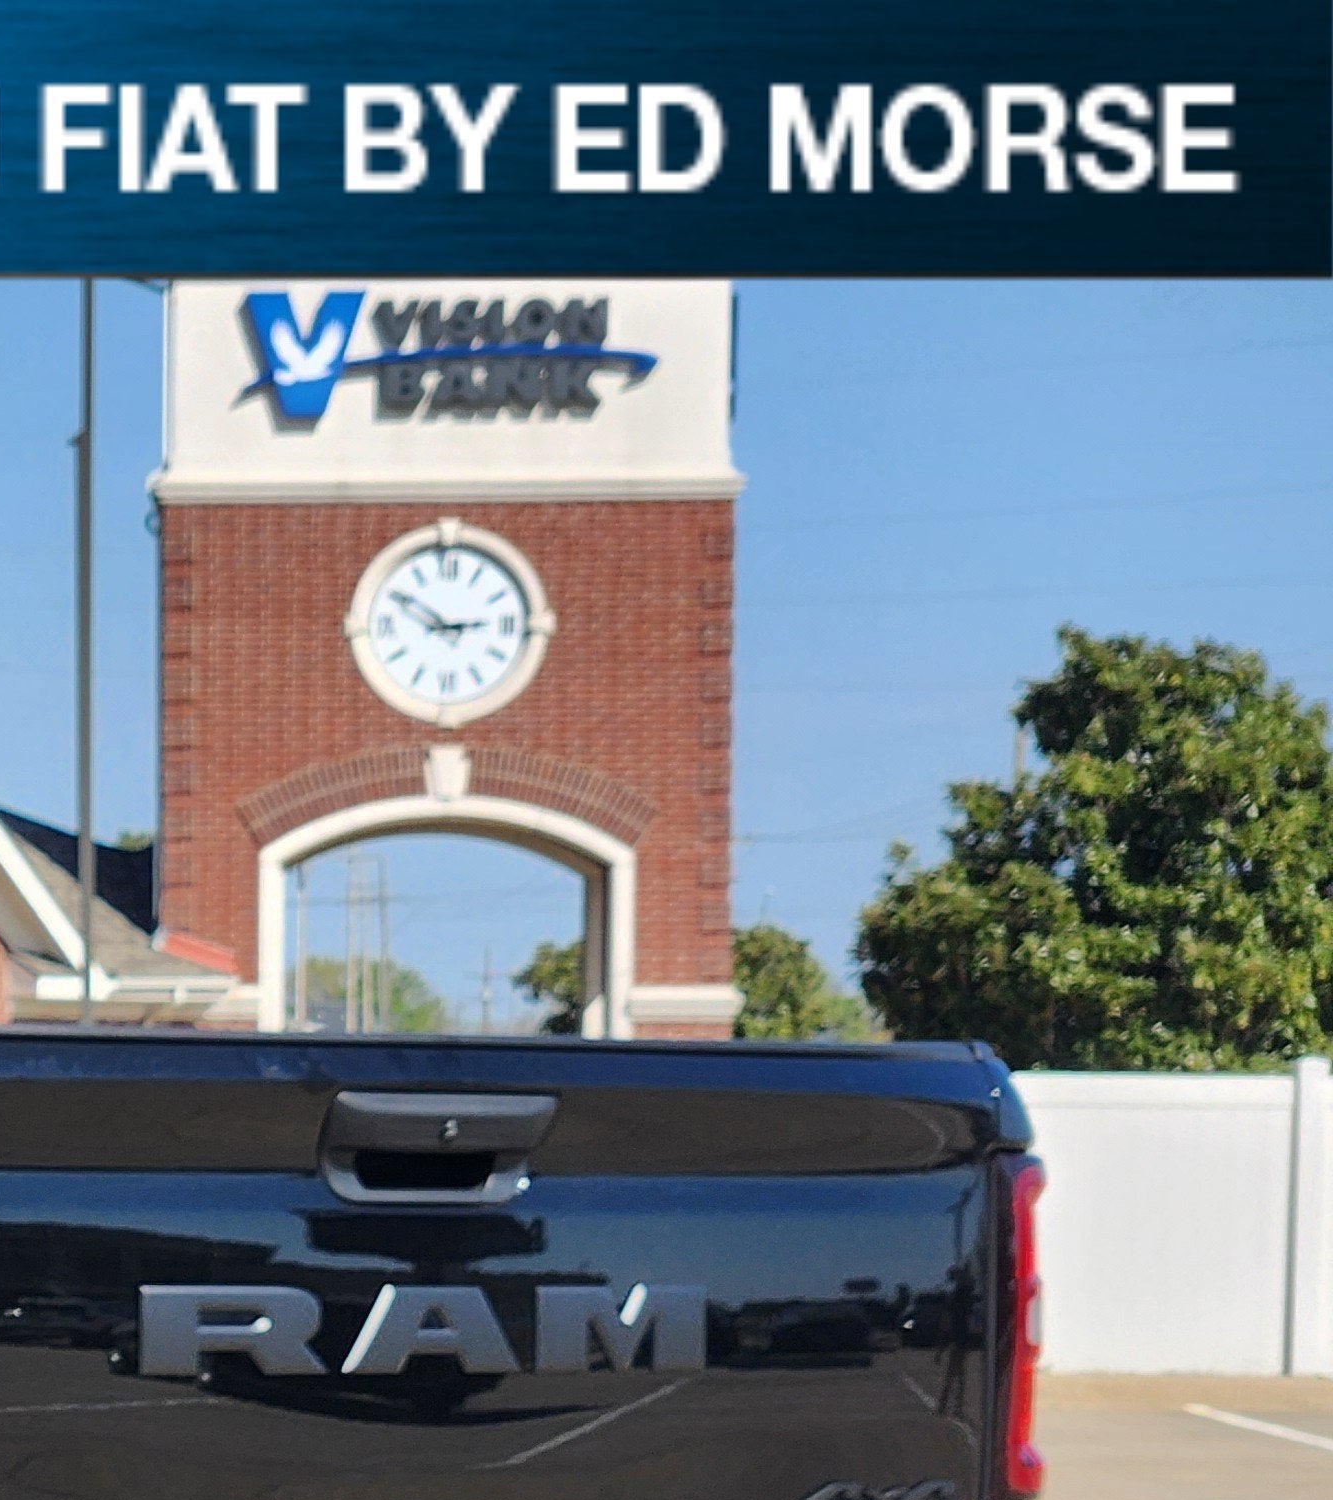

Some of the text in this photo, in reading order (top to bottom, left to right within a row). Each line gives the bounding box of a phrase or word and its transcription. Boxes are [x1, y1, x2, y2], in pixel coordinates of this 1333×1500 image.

[371, 297, 609, 350] VISION
[375, 355, 601, 418] BANK
[138, 1283, 707, 1376] RAM
